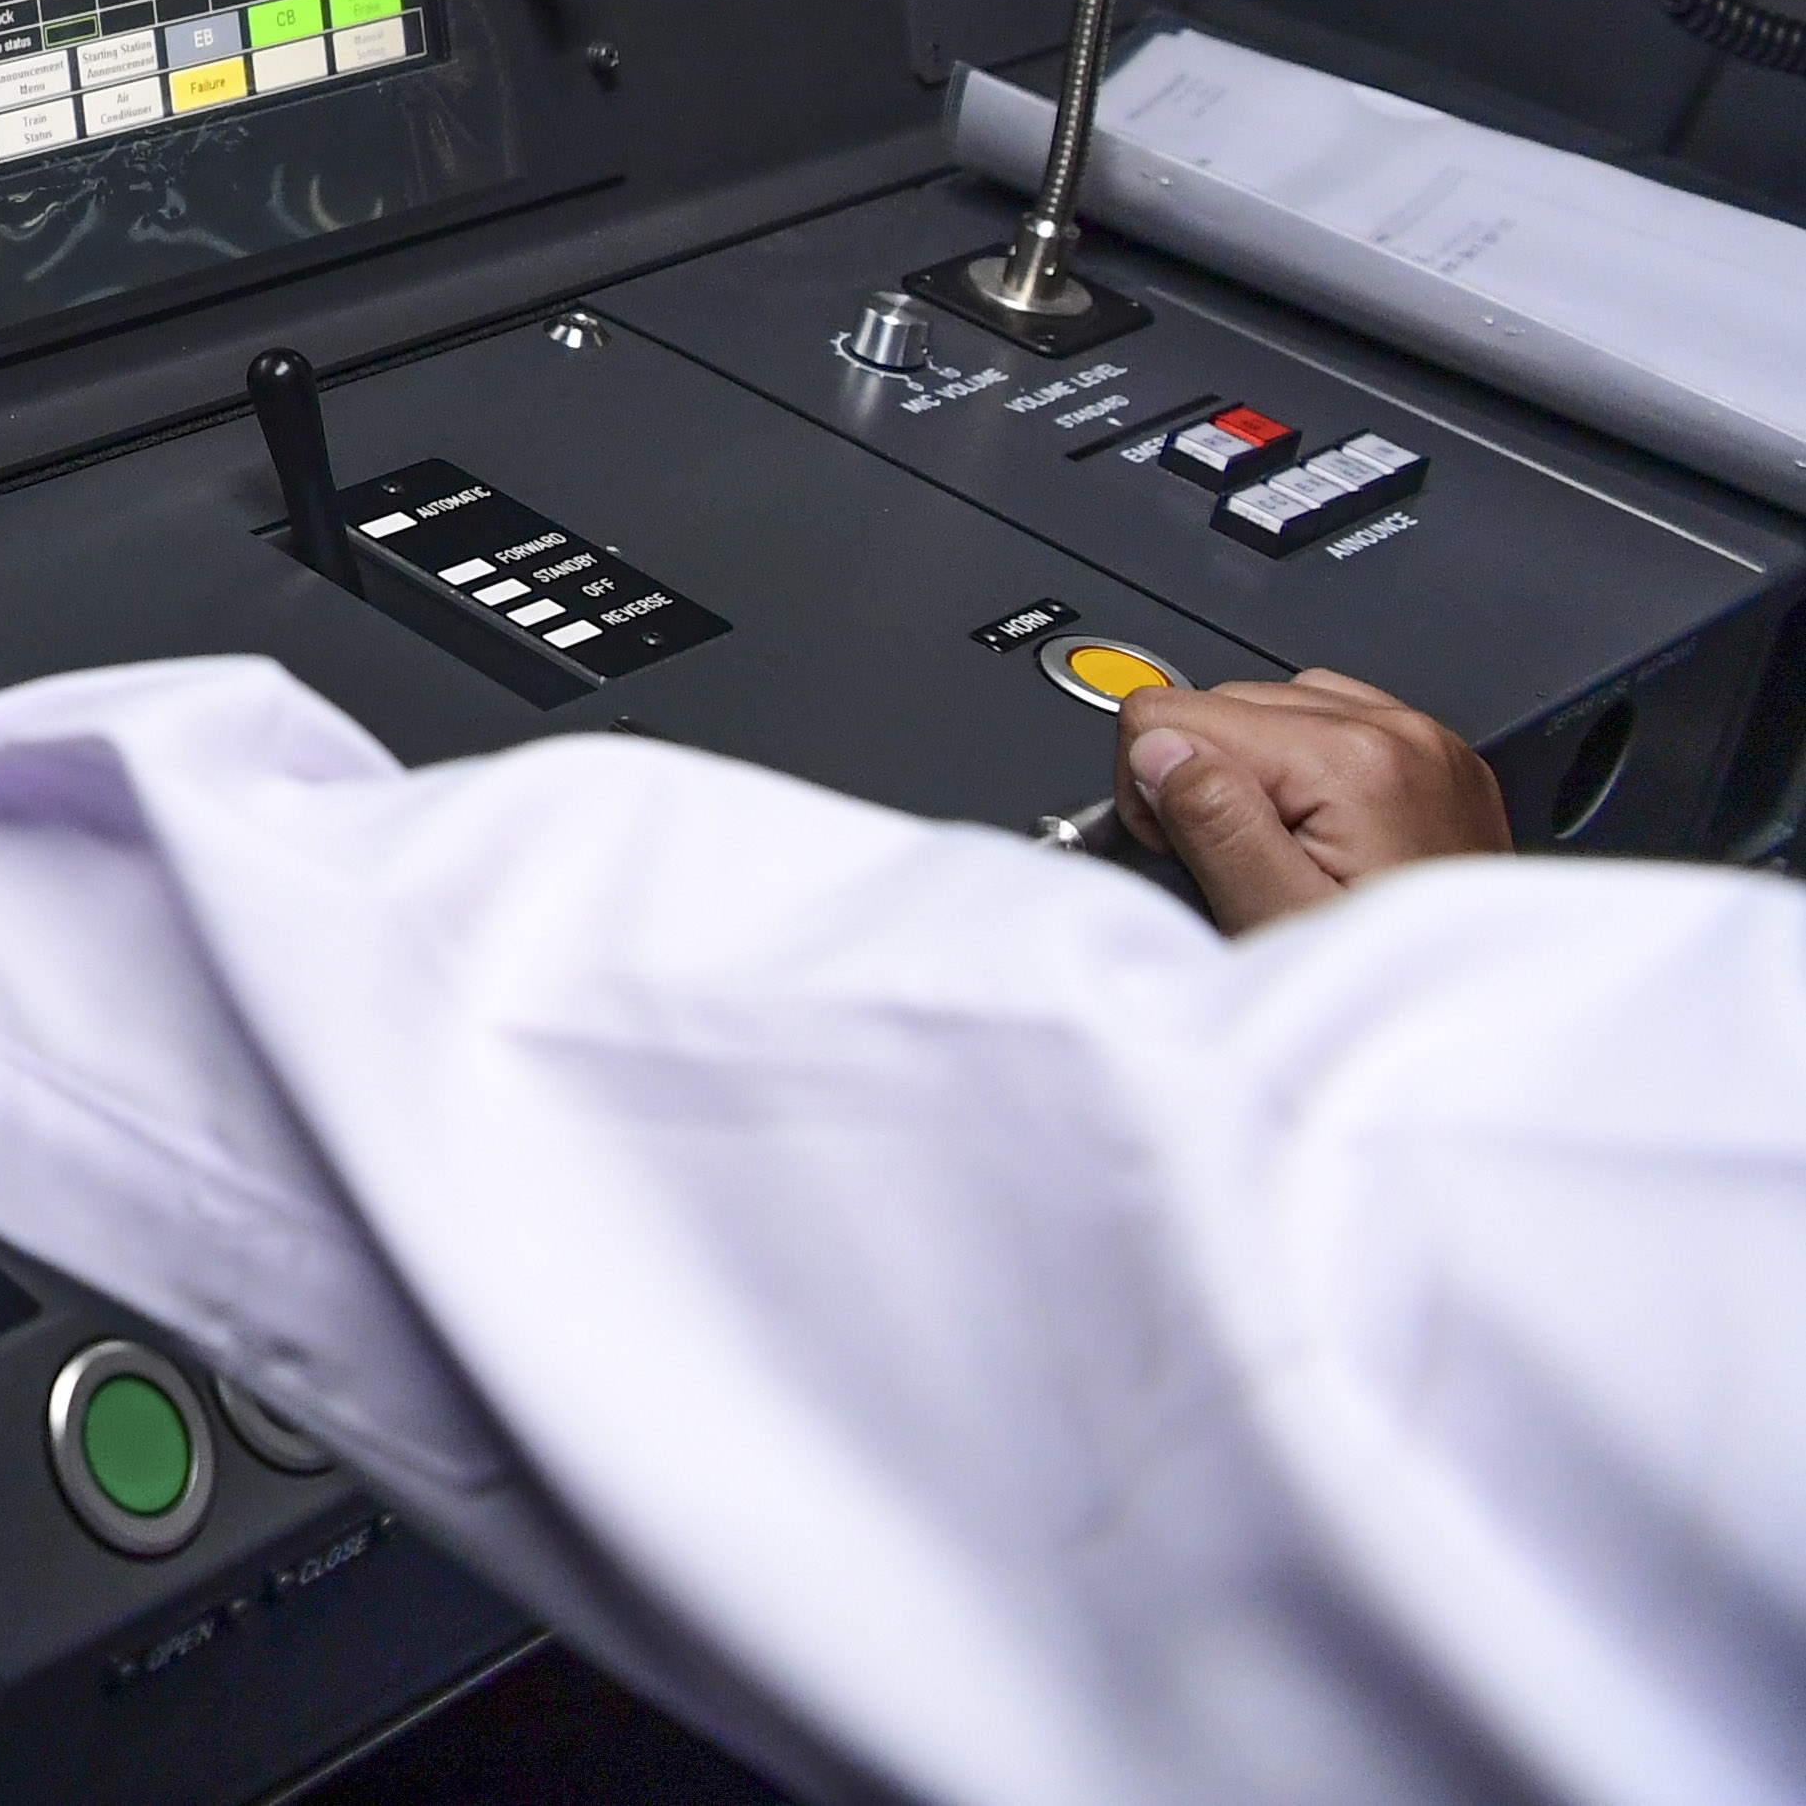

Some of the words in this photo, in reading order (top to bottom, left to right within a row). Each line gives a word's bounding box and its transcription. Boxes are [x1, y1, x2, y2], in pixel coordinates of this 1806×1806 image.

[276, 8, 296, 27] CB
[4, 36, 32, 52] status
[194, 28, 214, 48] EB
[82, 49, 119, 64] Starting
[120, 41, 152, 54] Station
[87, 55, 155, 80] Announcement
[190, 78, 226, 94] Failure
[116, 93, 129, 104] Air
[23, 115, 47, 128] Train
[100, 105, 152, 125] Conditioner
[24, 130, 53, 145] Status
[900, 394, 941, 414] MIC
[935, 368, 1009, 399] VOLUME
[1004, 381, 1077, 413] VOLUME
[1070, 363, 1128, 389] LEVEL
[416, 486, 491, 519] AUTOMATIC
[1325, 511, 1420, 560] ANNOUNCE
[494, 532, 568, 564] FORWARD
[532, 552, 599, 584] STANDBY
[581, 577, 616, 598] OFF
[600, 592, 674, 626] REVERSE
[997, 609, 1054, 638] HORN
